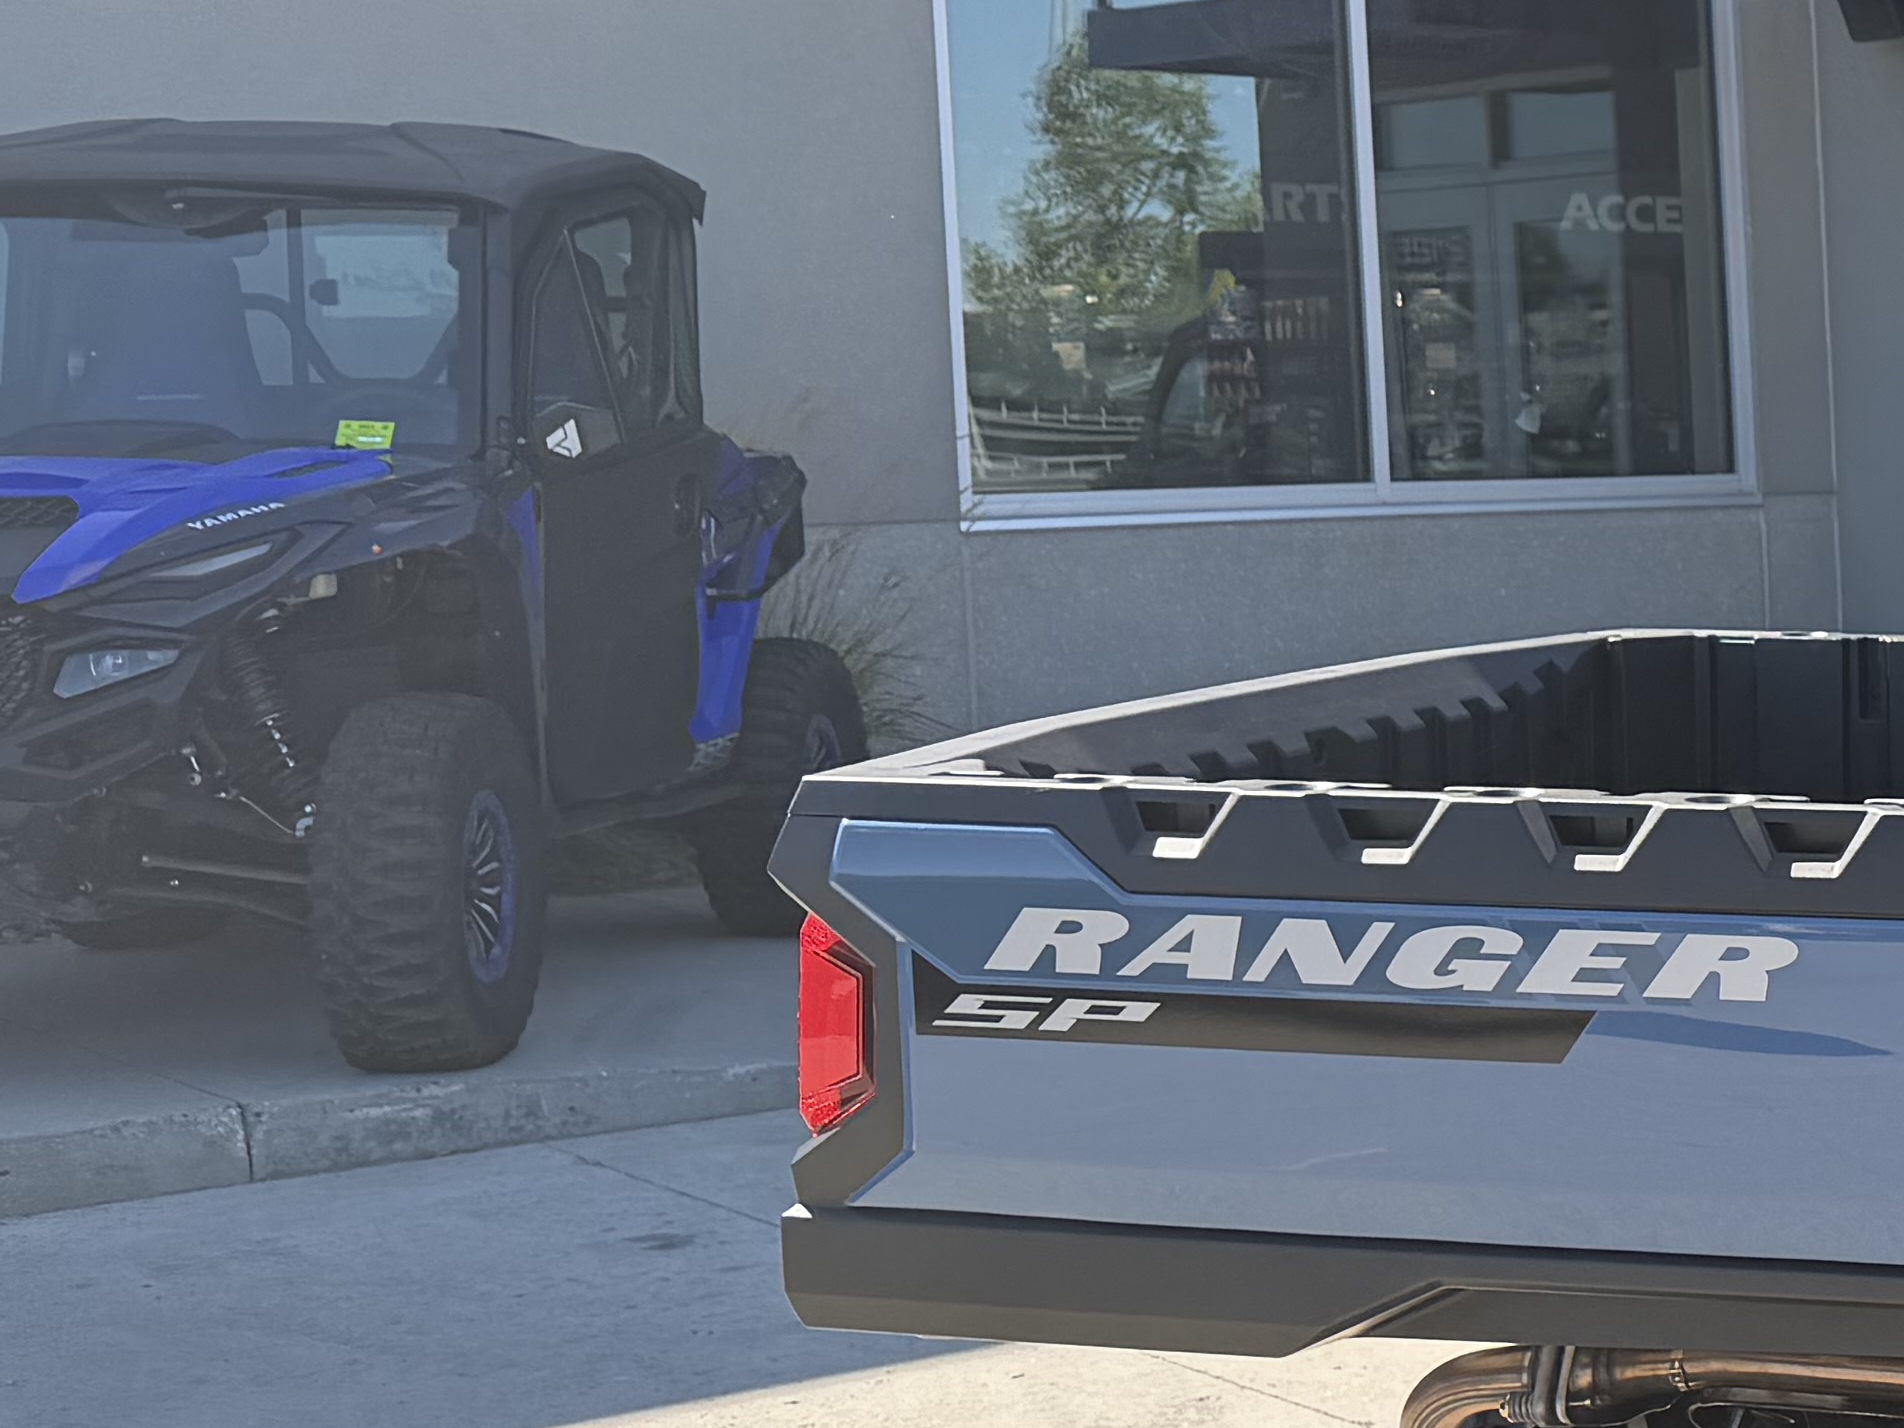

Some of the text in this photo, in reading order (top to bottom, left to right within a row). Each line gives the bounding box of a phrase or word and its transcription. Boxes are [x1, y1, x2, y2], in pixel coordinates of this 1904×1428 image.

[187, 501, 286, 531] YAMAHA
[983, 906, 1799, 1003] RANGER
[931, 994, 1161, 1033] SP
